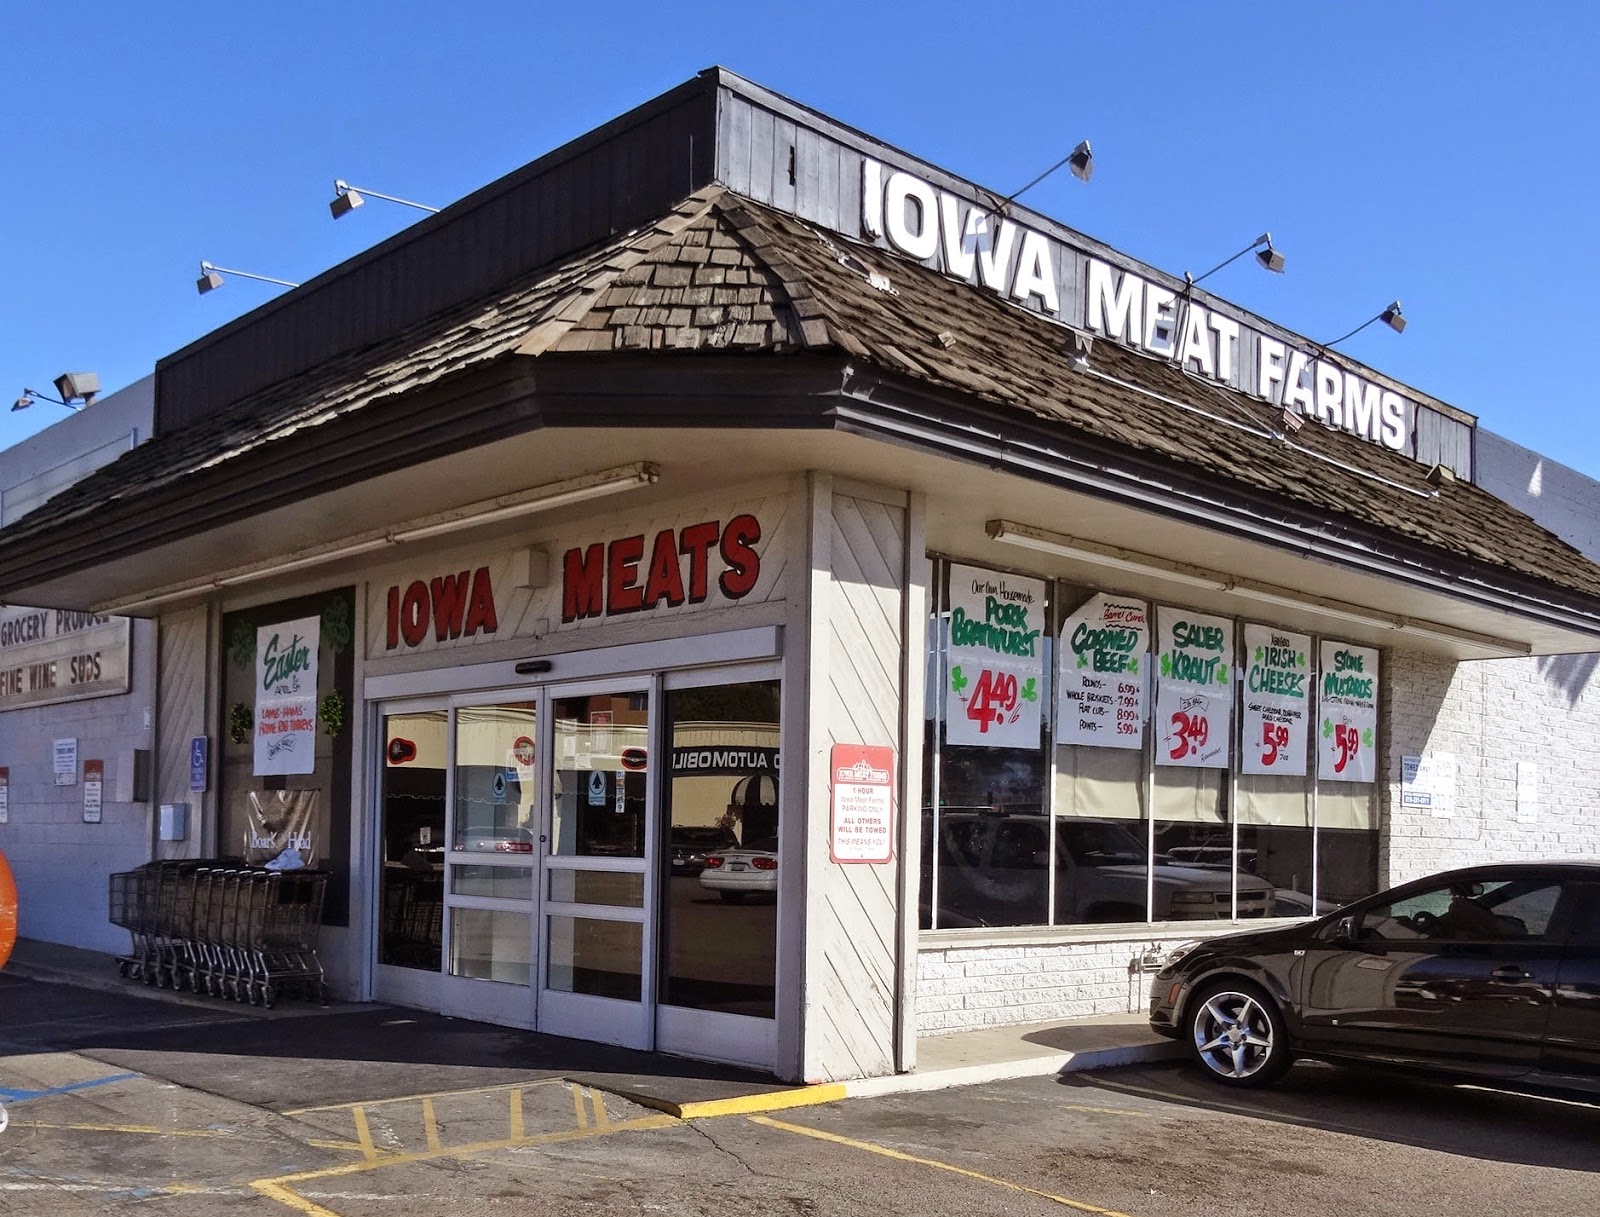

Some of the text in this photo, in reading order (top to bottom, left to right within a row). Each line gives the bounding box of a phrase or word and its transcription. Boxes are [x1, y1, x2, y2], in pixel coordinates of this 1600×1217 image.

[863, 158, 1406, 450] IOWA MEAT FARMS
[386, 513, 762, 651] IOWA MEATS
[971, 579, 985, 594] Our
[985, 580, 998, 595] Own
[985, 595, 1028, 632] PORK
[1, 611, 48, 646] GROCERY
[952, 606, 1040, 657] BRATWURST
[1070, 622, 1138, 655] CORNED
[1171, 621, 1224, 653] SAUER
[263, 633, 310, 691] Easter
[1092, 649, 1130, 674] BEEF
[1171, 650, 1221, 685] KRAUT
[1264, 646, 1296, 668] IRISH
[1334, 648, 1363, 673] STONE
[0, 651, 101, 696] FINE WINE SUDS
[1249, 664, 1305, 699] CHEESES
[1324, 672, 1373, 699] MUSTARDS
[1066, 688, 1085, 701] WHOLE
[1118, 696, 1135, 707] 7.99
[1117, 684, 1136, 694] 6.99
[1116, 708, 1135, 721] 8.99
[1116, 723, 1134, 734] 5.99
[841, 804, 884, 813] PARKING ONLY
[857, 817, 882, 825] OTHERS
[865, 826, 887, 834] TOWED
